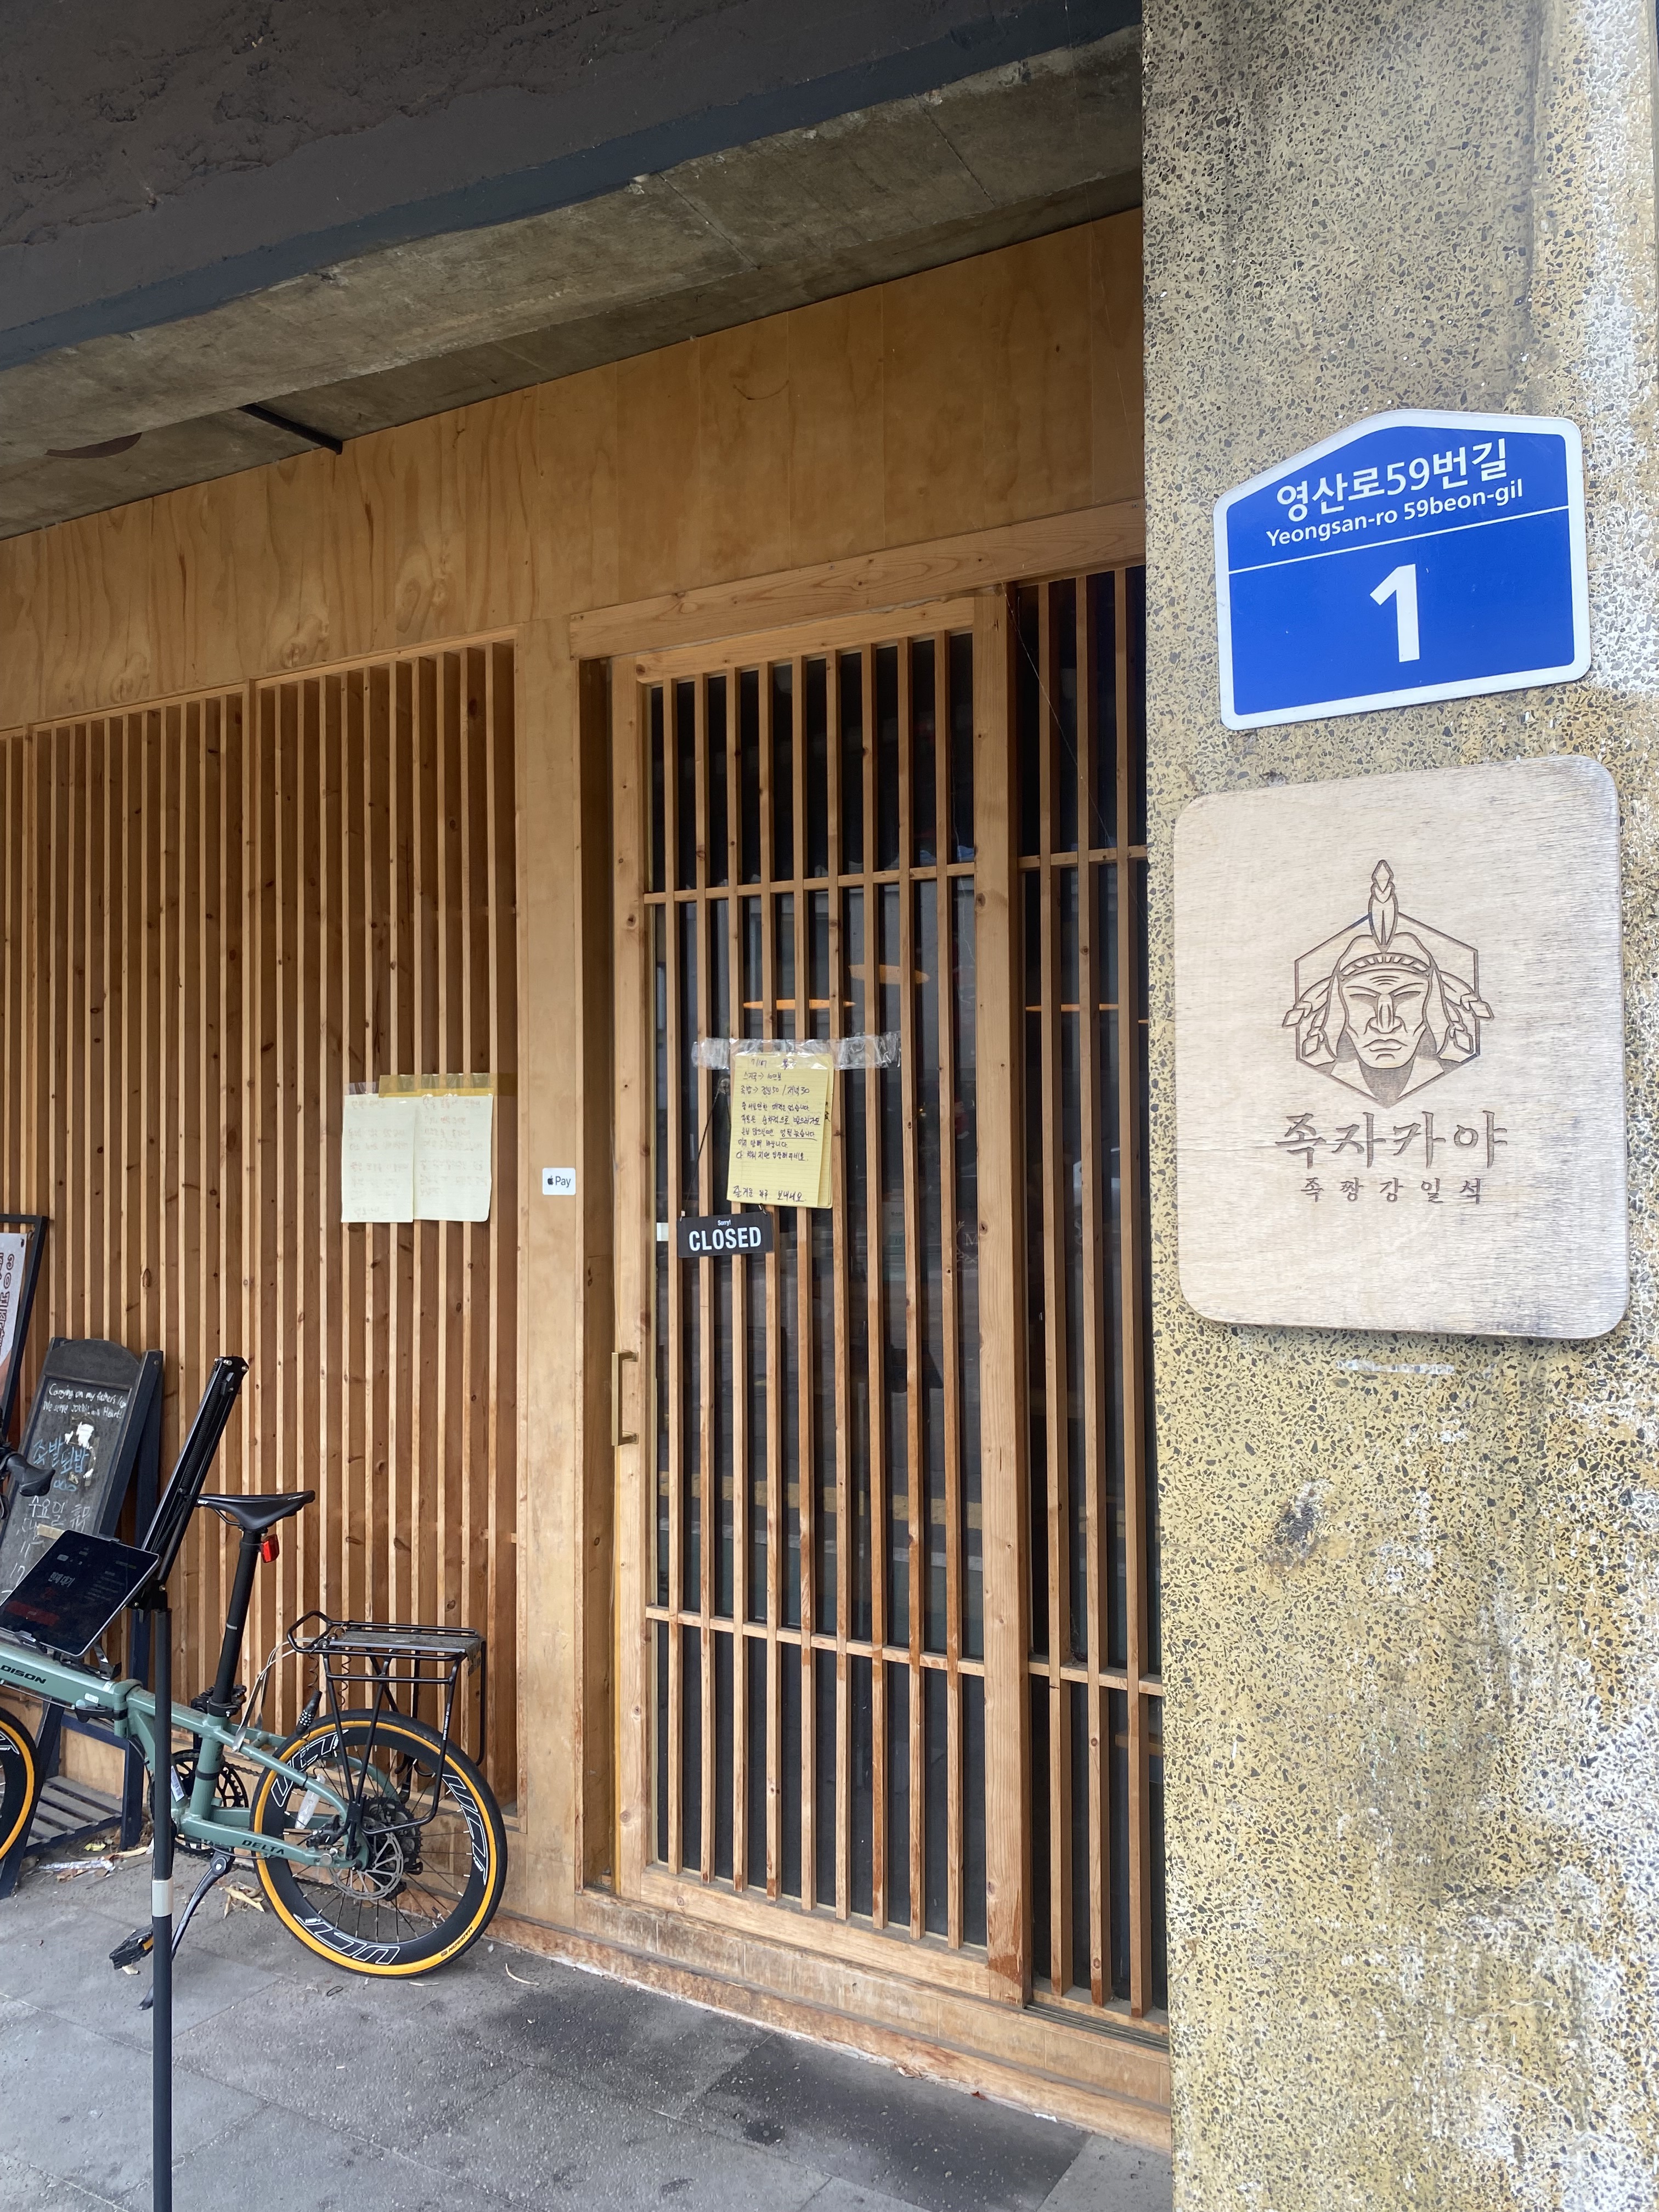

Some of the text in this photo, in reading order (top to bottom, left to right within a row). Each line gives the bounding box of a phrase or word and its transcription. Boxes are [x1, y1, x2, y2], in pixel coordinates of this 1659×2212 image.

[1277, 438, 1508, 522] 영산로59번길
[1266, 479, 1523, 546] Yeongsan-ro 59beon-gil
[1370, 564, 1420, 662] 1
[1275, 1110, 1508, 1170] 족자카야
[555, 1176, 572, 1188] Pay
[689, 1226, 762, 1252] CLOSED
[241, 1839, 285, 1855] DELTA
